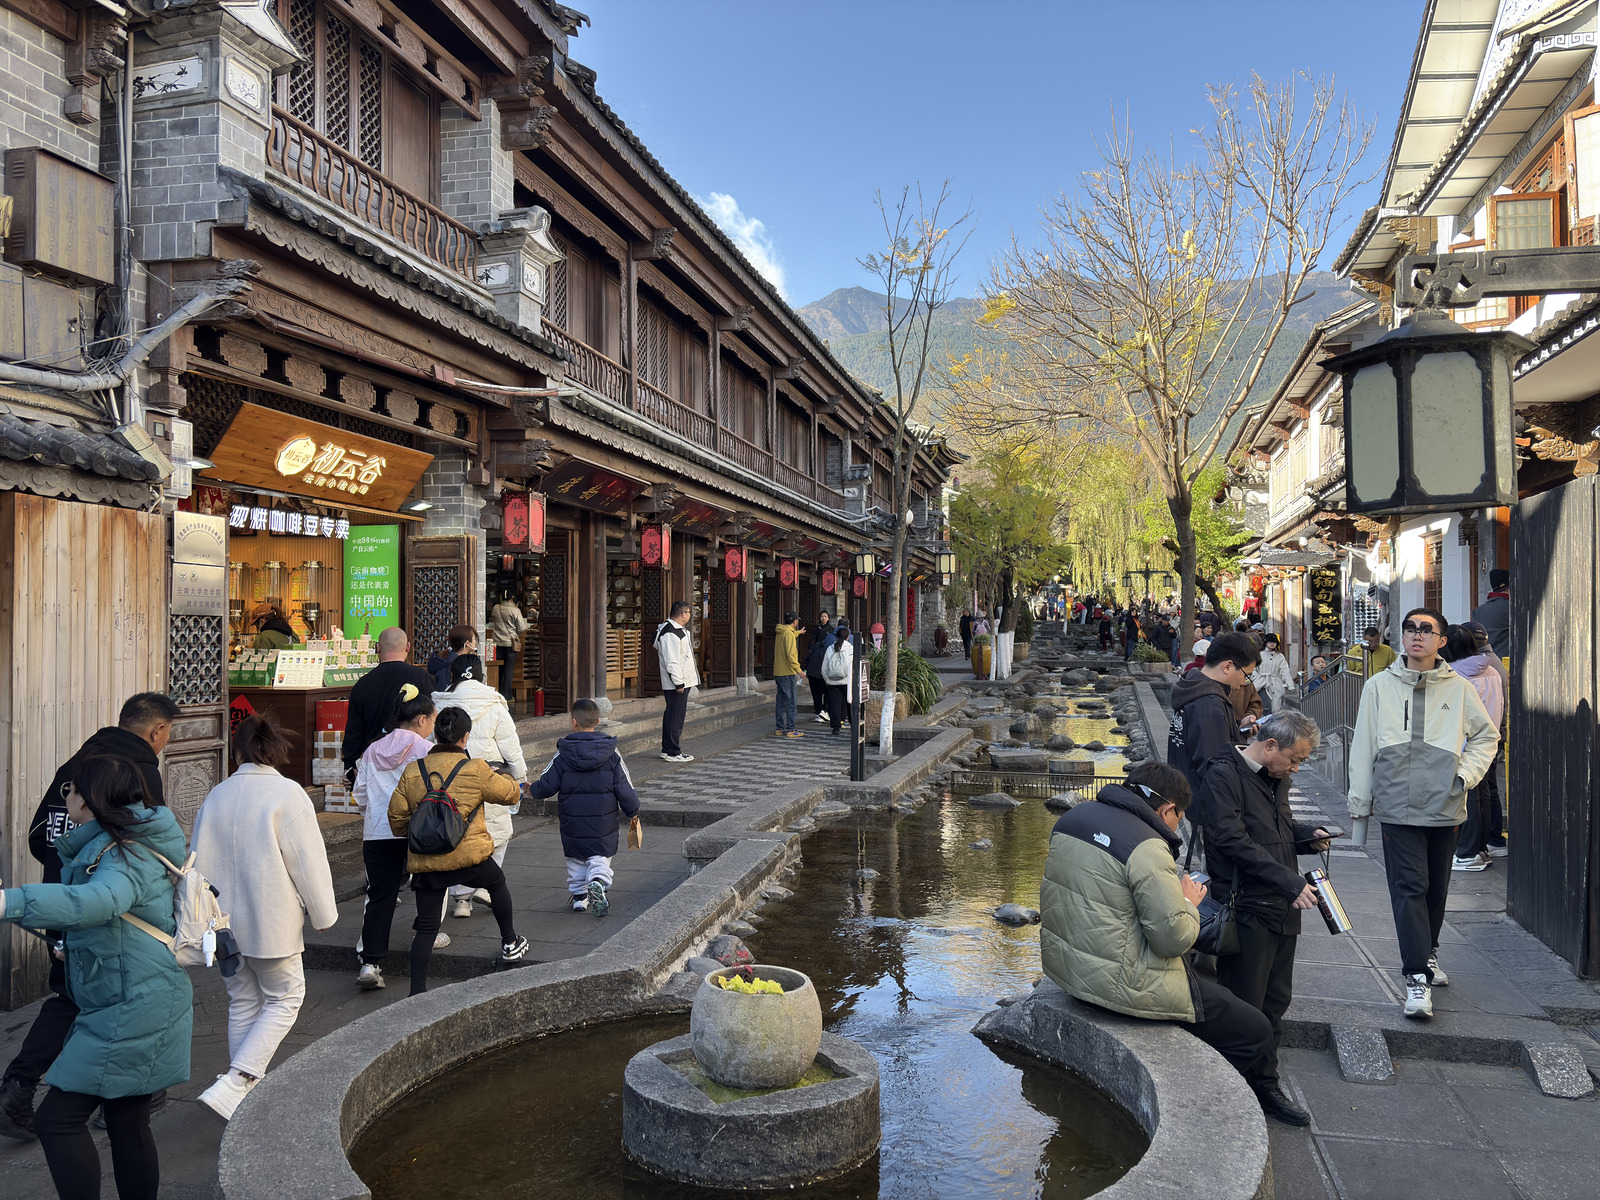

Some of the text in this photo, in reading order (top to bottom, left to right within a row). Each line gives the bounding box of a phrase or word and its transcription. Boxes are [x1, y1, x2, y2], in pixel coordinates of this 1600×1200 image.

[284, 448, 312, 464] 初云谷
[310, 441, 386, 484] 初云谷
[228, 503, 350, 540] 现烘咖啡豆专卖
[507, 515, 527, 538] 茶
[643, 541, 660, 560] 茶
[727, 560, 741, 574] 茶
[177, 586, 221, 596] 云南大学农学院
[186, 600, 222, 609] 教学实践基地
[1313, 576, 1340, 641] 缅甸玉批发
